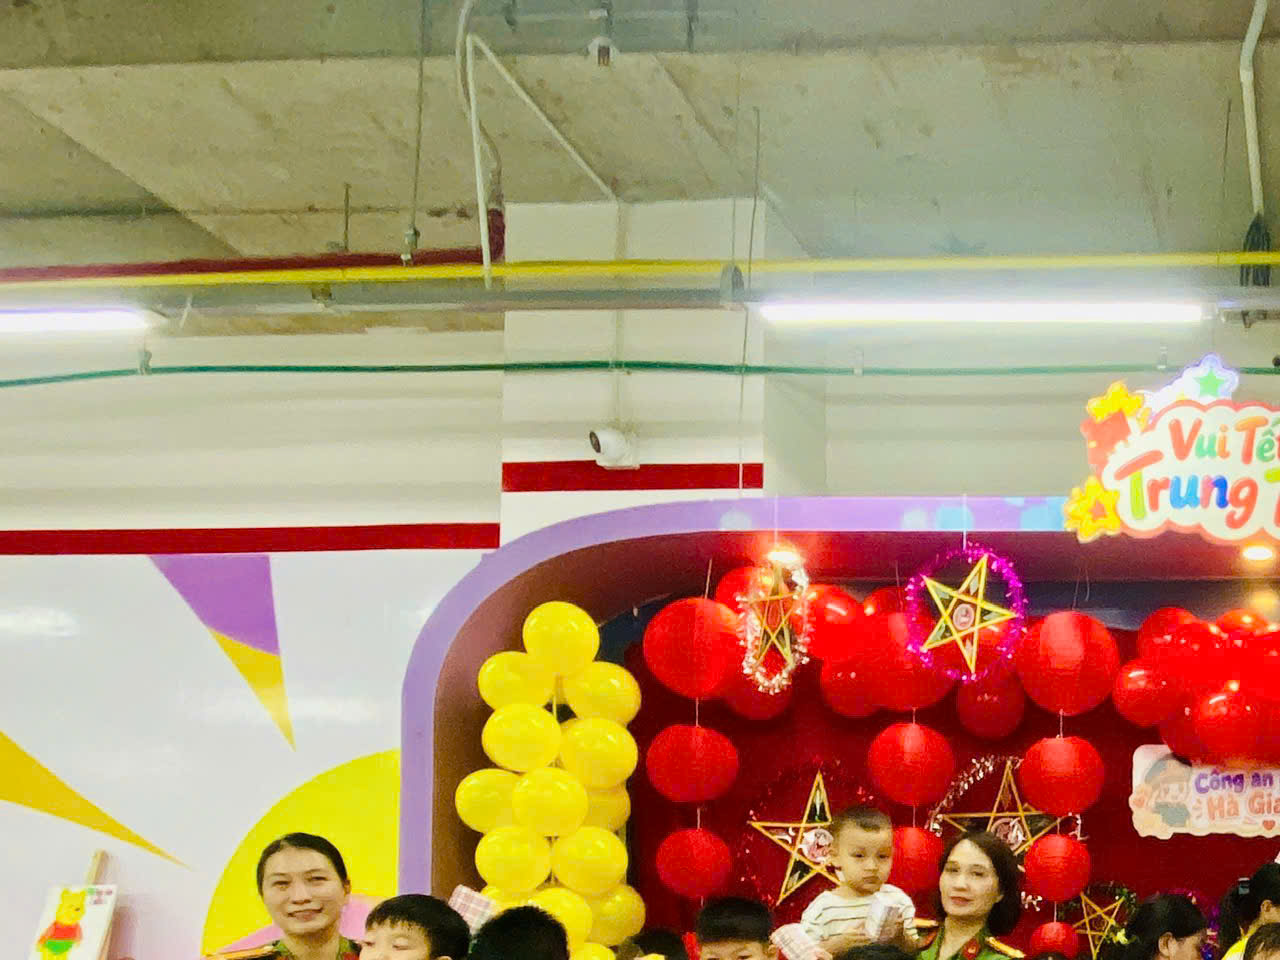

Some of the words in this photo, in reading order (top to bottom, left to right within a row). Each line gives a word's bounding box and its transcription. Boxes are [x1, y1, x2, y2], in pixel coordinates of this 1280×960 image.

[1169, 417, 1230, 460] Vui
[1113, 449, 1259, 530] Trung
[1195, 769, 1245, 794] Công
[1251, 772, 1274, 788] an
[1207, 793, 1239, 820] Hà
